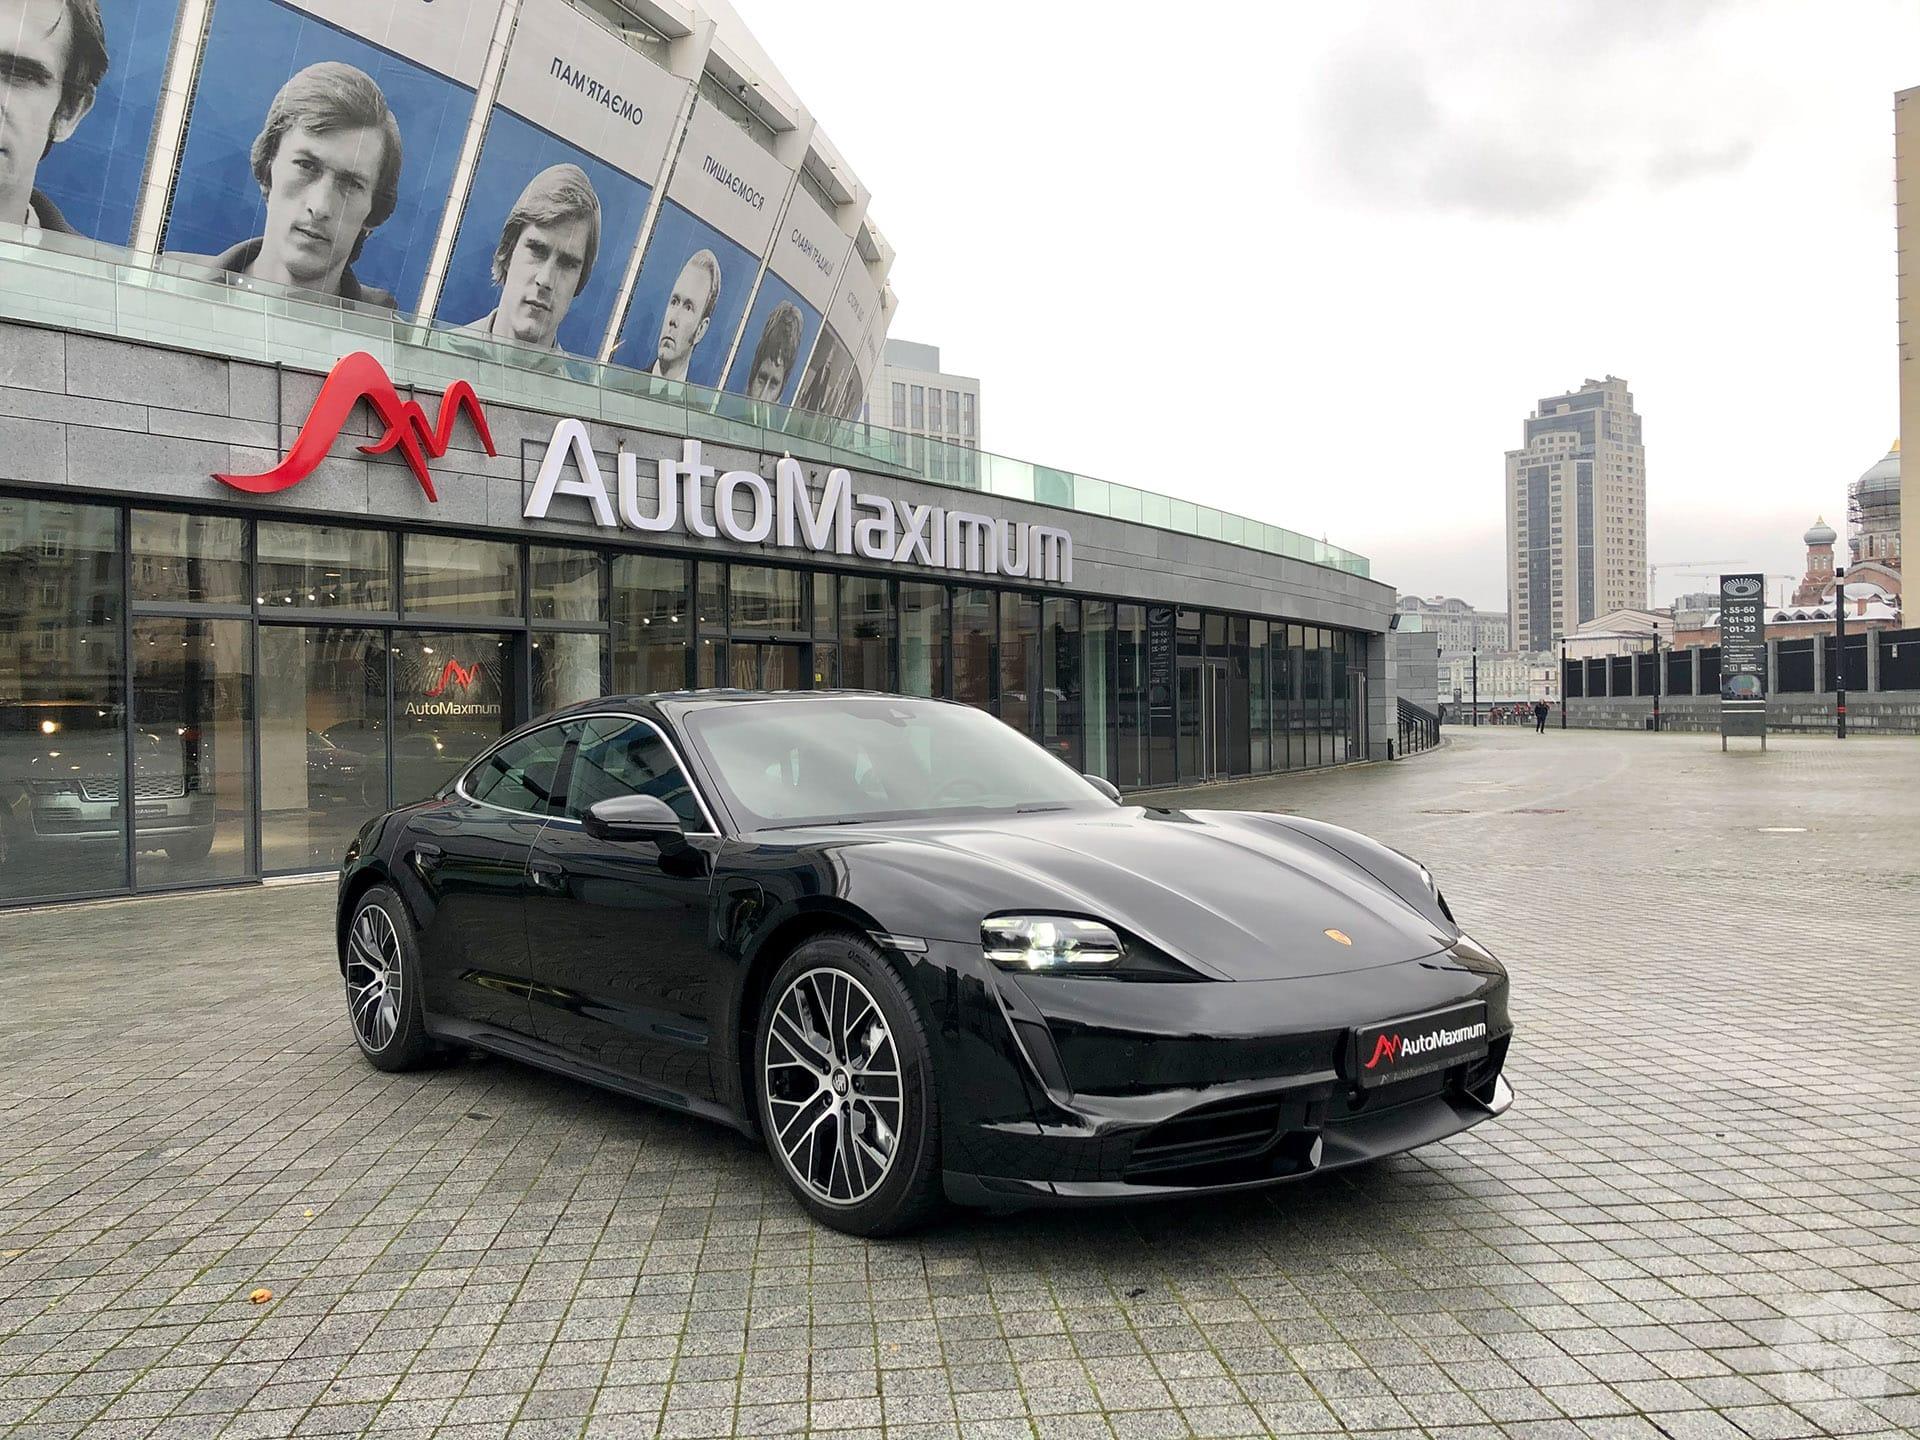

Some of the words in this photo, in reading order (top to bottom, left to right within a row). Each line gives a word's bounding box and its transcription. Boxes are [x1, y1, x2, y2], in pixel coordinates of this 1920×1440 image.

[549, 56, 644, 126] ПАМ'ЯТАЄМО
[702, 154, 765, 212] ПИШАЄМОСЯ
[523, 418, 1073, 583] AutoMaximum
[1729, 606, 1756, 614] 55-60
[1729, 615, 1756, 624] 61-80
[1729, 625, 1756, 633] 01-22
[405, 702, 501, 715] AutoMaximum
[1400, 1022, 1486, 1057] AutoMaximum
